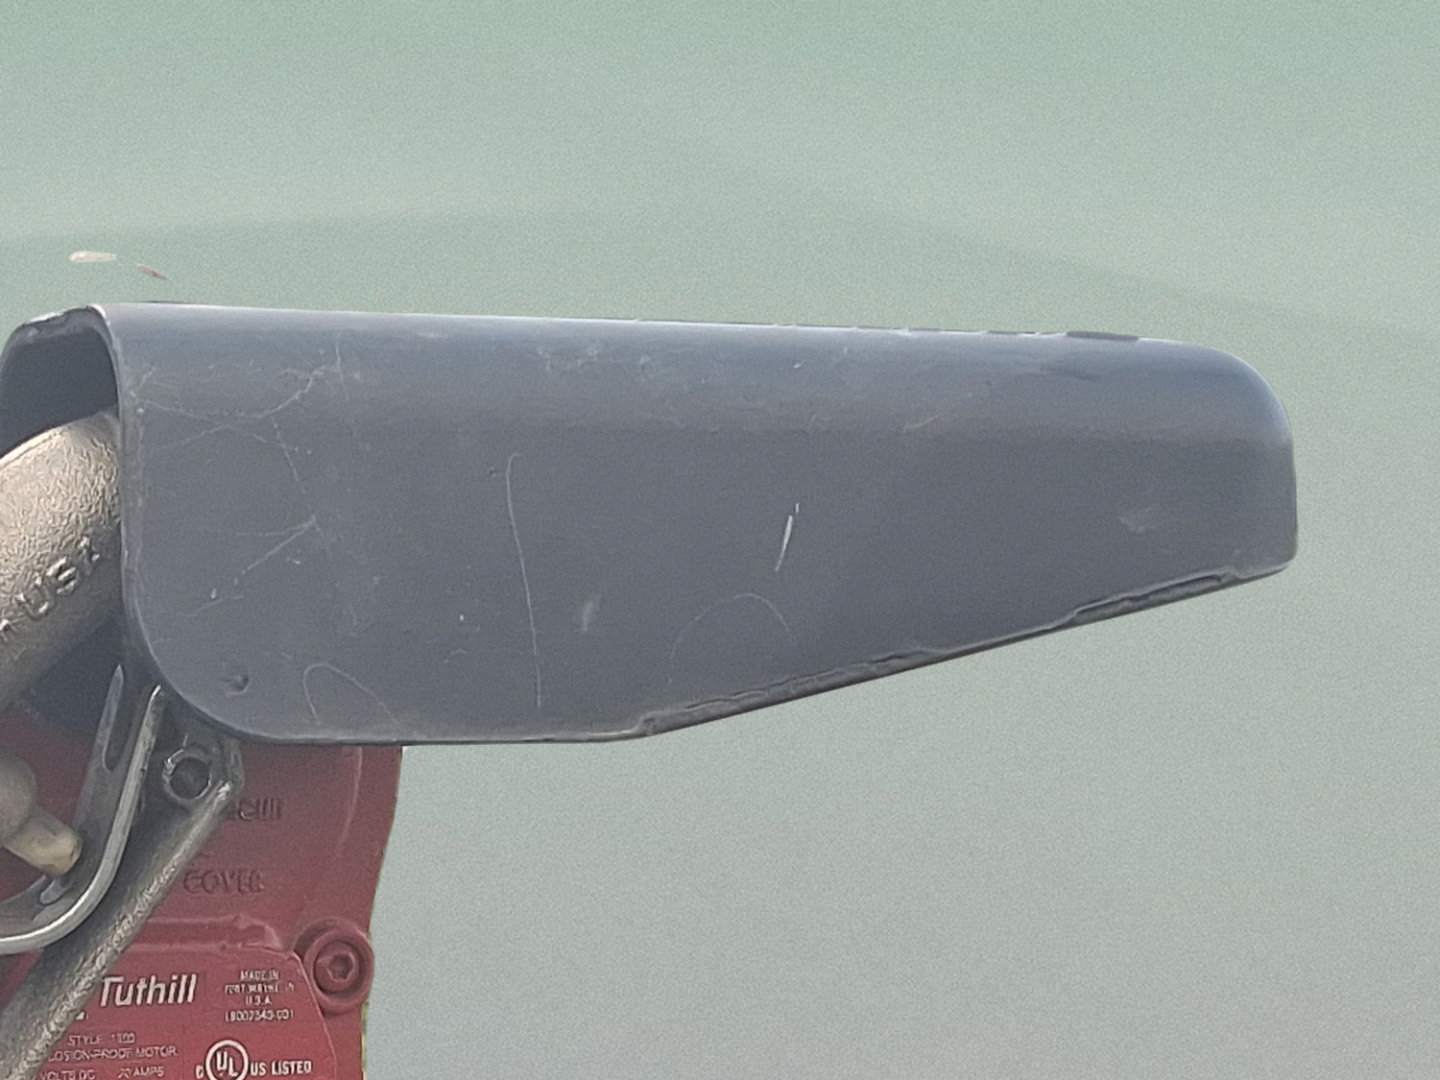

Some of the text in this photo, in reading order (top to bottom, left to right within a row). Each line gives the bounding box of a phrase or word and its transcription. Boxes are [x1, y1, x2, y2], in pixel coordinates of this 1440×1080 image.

[98, 973, 198, 1009] Tuthill
[135, 1045, 178, 1059] MOTOR
[250, 1061, 267, 1077] US
[271, 1060, 313, 1076] LISTED
